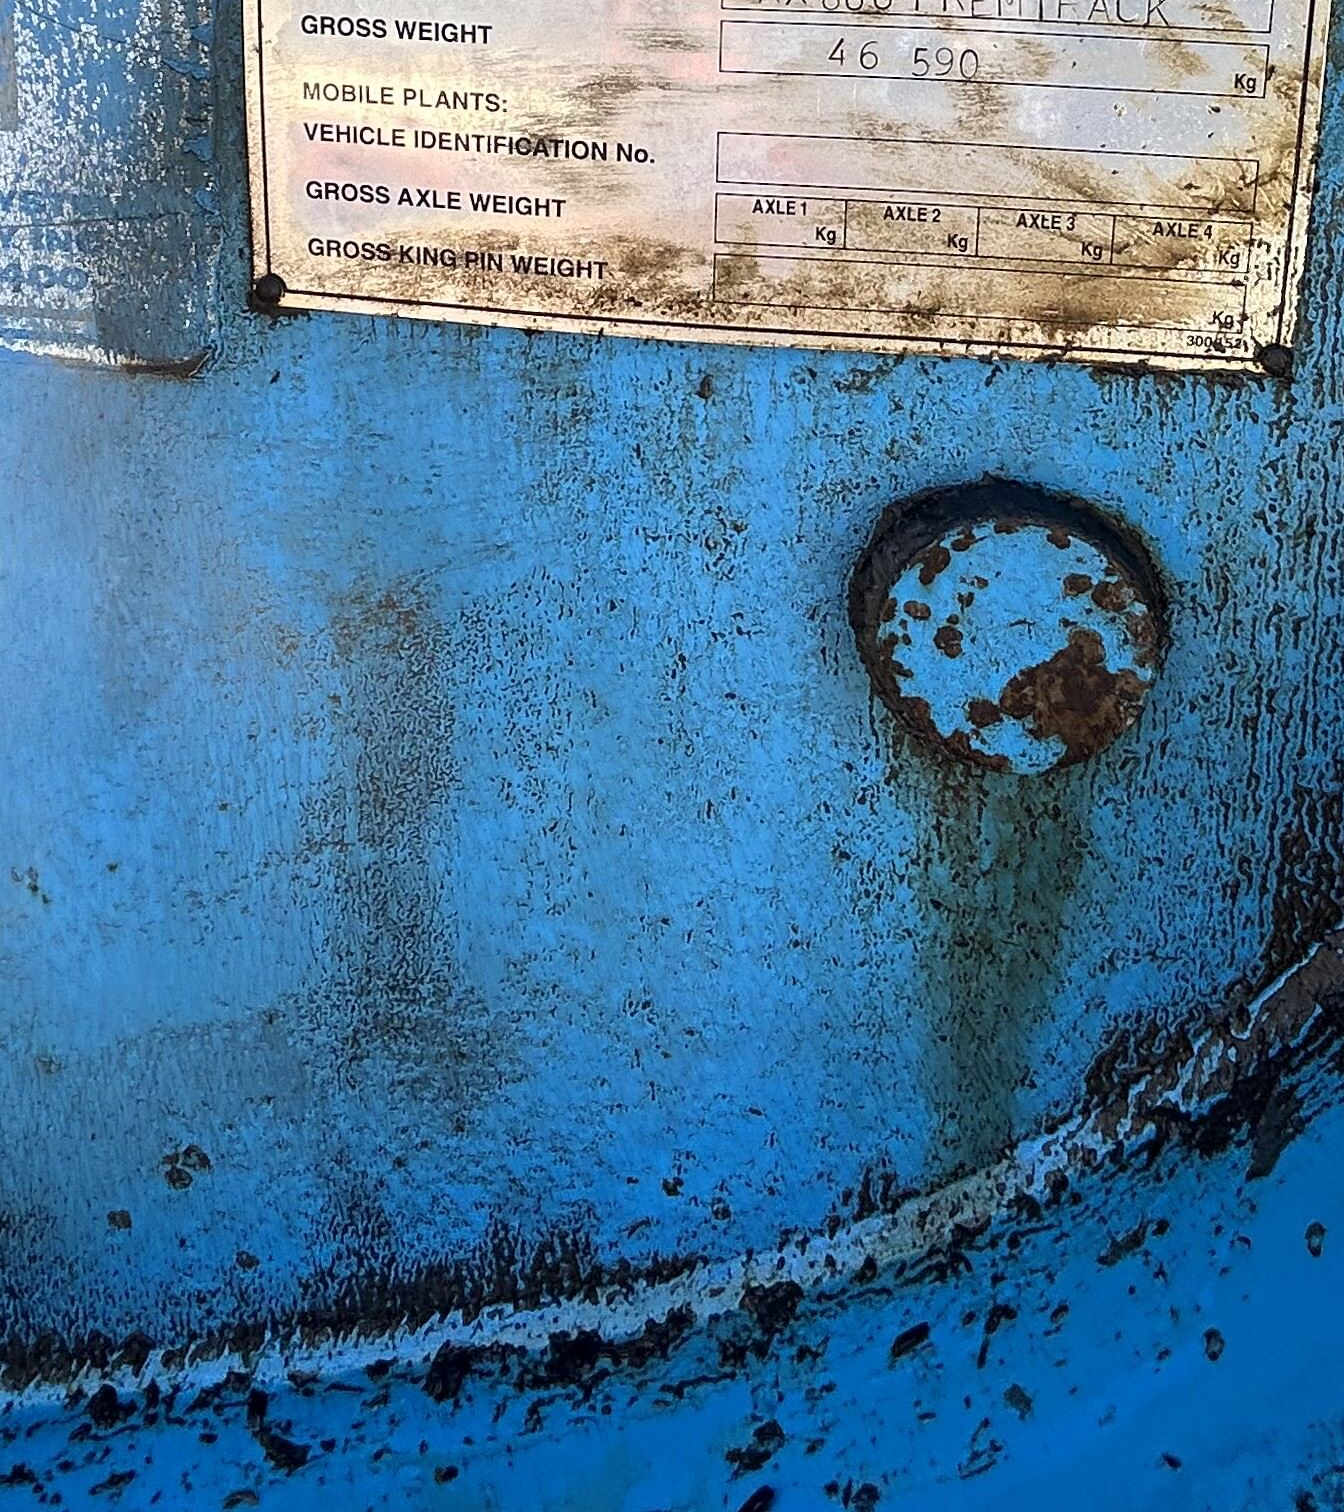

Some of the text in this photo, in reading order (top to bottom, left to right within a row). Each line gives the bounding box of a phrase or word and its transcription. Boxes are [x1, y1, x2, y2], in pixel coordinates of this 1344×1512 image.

[301, 15, 493, 45] GROSS WEIGHT
[827, 37, 1257, 93] 46 590 Kg
[303, 82, 508, 113] MOBILE PLANTS:
[304, 122, 656, 164] VEHICLE IDENTIFICATION No.
[305, 180, 567, 218] GROSS AXLE WEIGHT
[752, 198, 808, 216] AXLE 1
[883, 205, 941, 223] AXLE 2
[1016, 212, 1077, 232] AXLE 3
[815, 226, 837, 245] Kg
[1152, 219, 1213, 241] AXLE 4
[947, 233, 969, 253] Kg
[1082, 241, 1103, 261] Kg
[307, 237, 608, 280] GROSS KING PIN WEIGHT
[1219, 248, 1241, 268] Kg
[1209, 310, 1234, 330] Kg
